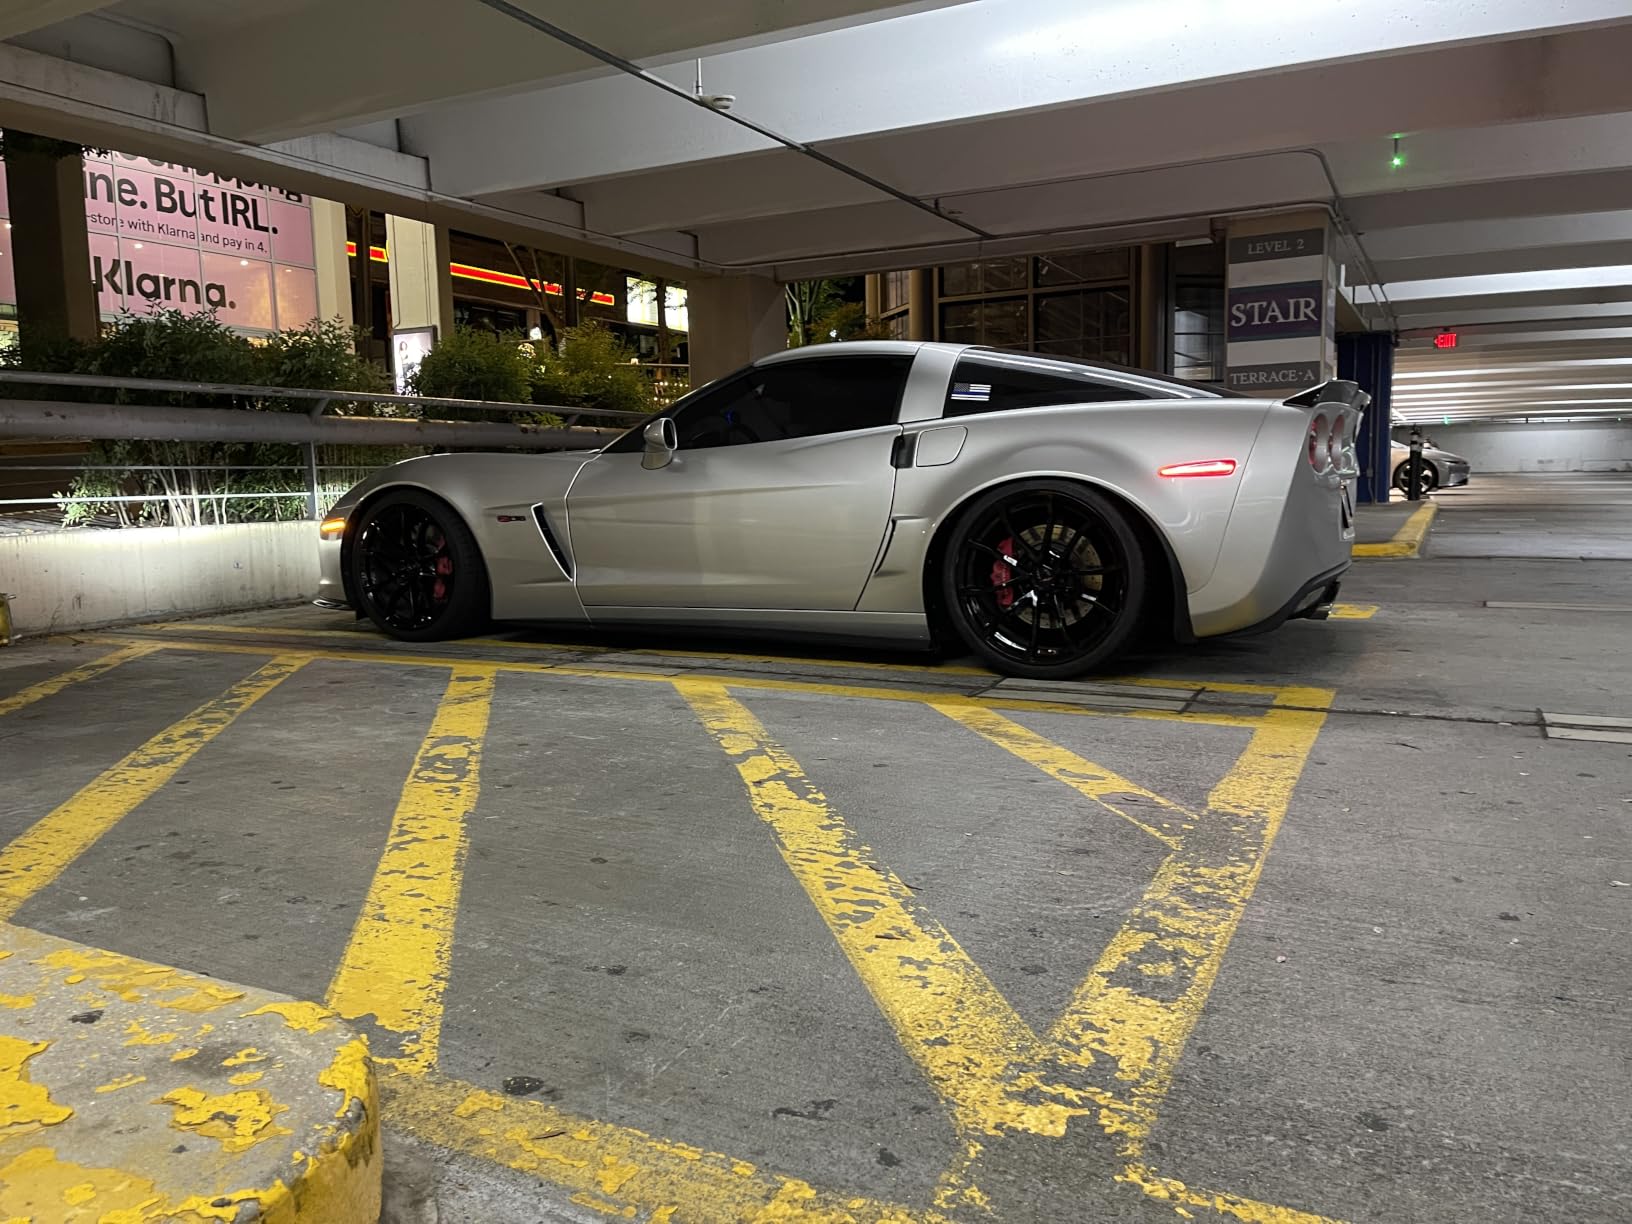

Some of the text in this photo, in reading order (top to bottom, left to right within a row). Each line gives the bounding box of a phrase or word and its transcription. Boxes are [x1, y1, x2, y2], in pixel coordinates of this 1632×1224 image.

[154, 176, 217, 223] But
[221, 191, 278, 235] IRL.
[127, 219, 155, 233] with
[157, 222, 196, 240] Klarna
[201, 233, 219, 244] and
[222, 236, 242, 250] pay
[245, 238, 255, 251] in
[257, 241, 268, 254] 4.
[1247, 238, 1305, 255] LEVEL 2
[93, 255, 237, 310] Klarna.
[1231, 297, 1318, 327] STAIR
[1436, 333, 1457, 348] EXIT
